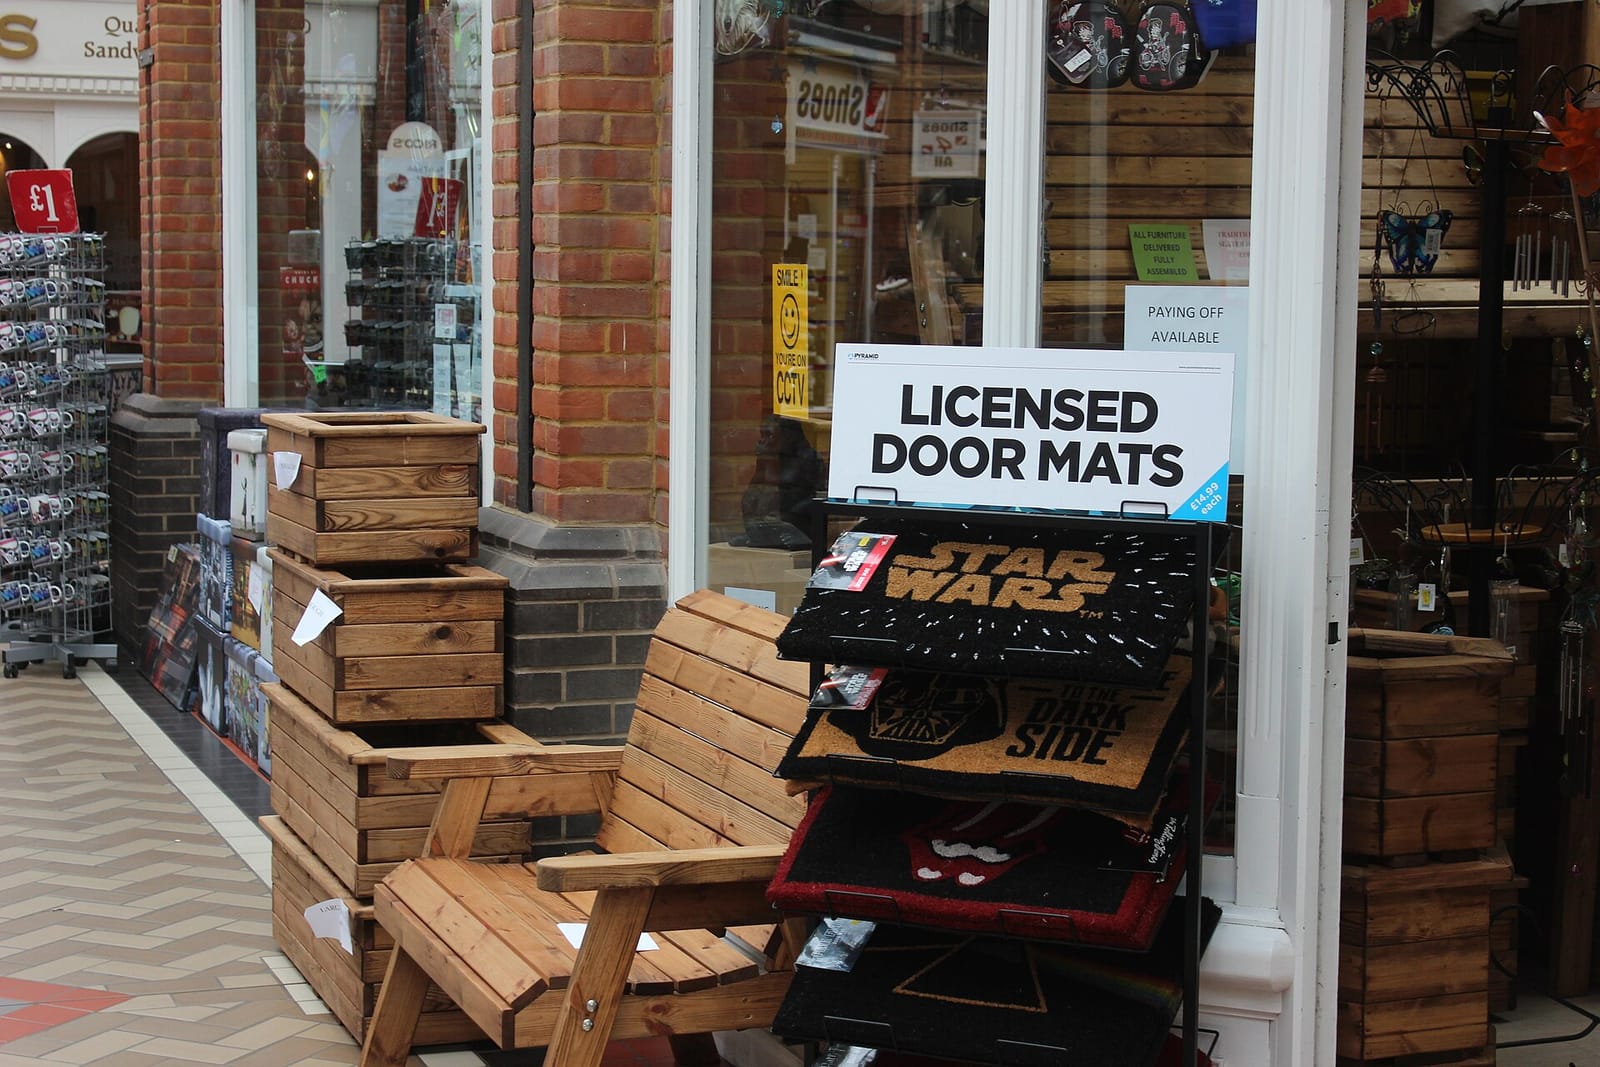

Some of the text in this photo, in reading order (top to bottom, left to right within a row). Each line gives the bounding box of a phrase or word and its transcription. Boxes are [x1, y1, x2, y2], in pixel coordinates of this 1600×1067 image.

[30, 184, 60, 222] £1
[1143, 244, 1180, 252] DELIVERED
[1153, 256, 1174, 264] FULLY
[776, 269, 798, 286] SMILE
[1148, 306, 1224, 318] PAYING OFF
[1151, 331, 1220, 343] AVAILABLE
[776, 371, 805, 406] CCTV
[900, 384, 1159, 433] LICENSED
[871, 433, 1184, 487] DOOR MATS
[1190, 482, 1219, 511] £14.99
[1201, 494, 1222, 514] each
[892, 541, 1116, 584] STAR
[885, 566, 1110, 612] WARS
[1025, 698, 1136, 731] DARK
[1005, 723, 1121, 765] SIDE
